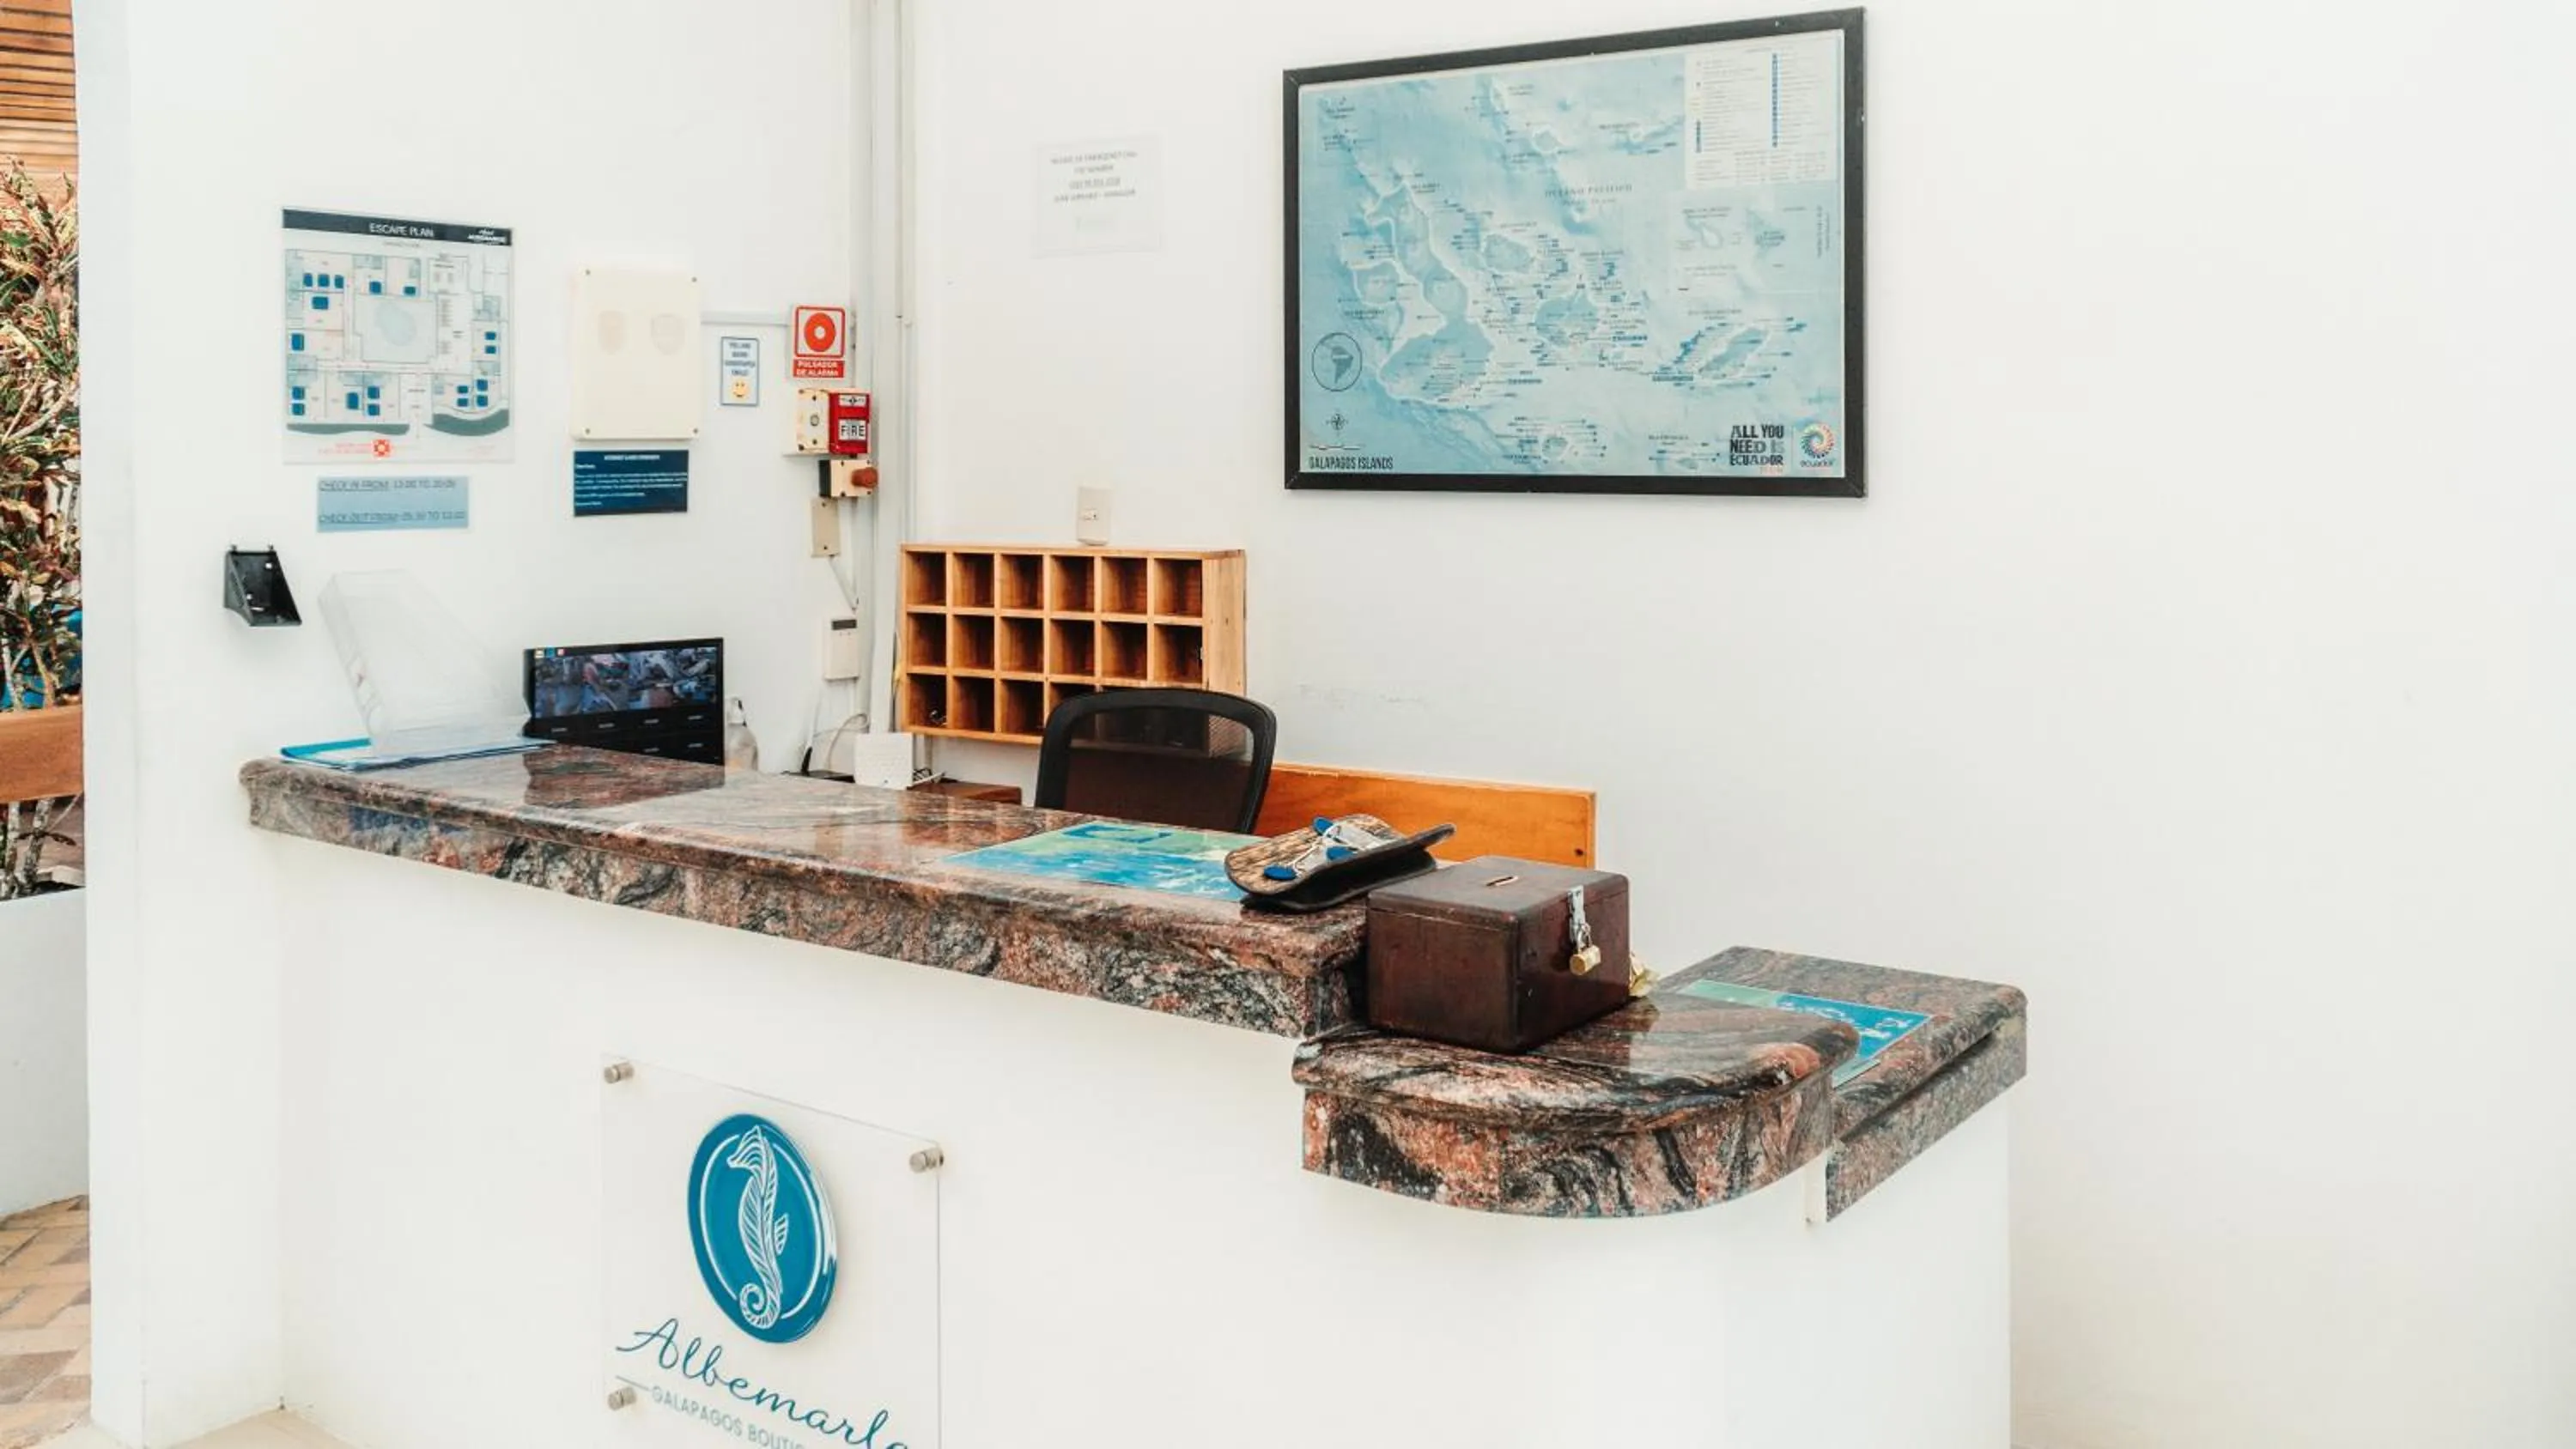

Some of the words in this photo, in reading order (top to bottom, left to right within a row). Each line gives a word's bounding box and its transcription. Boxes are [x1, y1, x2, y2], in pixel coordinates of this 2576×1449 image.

[369, 222, 407, 235] ESCAPE
[410, 226, 434, 238] PLAN
[798, 360, 838, 368] PULSADOR
[841, 425, 865, 437] FIRE
[1730, 425, 1759, 439] ALL
[1761, 424, 1784, 439] YOU
[1730, 439, 1766, 454] NEED
[1771, 440, 1785, 454] IS
[1308, 456, 1356, 470] GALAPAGOS
[1358, 456, 1394, 470] ISLANDS
[1730, 454, 1784, 466] ECUADOR
[319, 480, 349, 491] CHECK
[319, 513, 350, 524] CHECK
[427, 511, 440, 520] TO
[652, 1385, 742, 1438] GALAPAGOS
